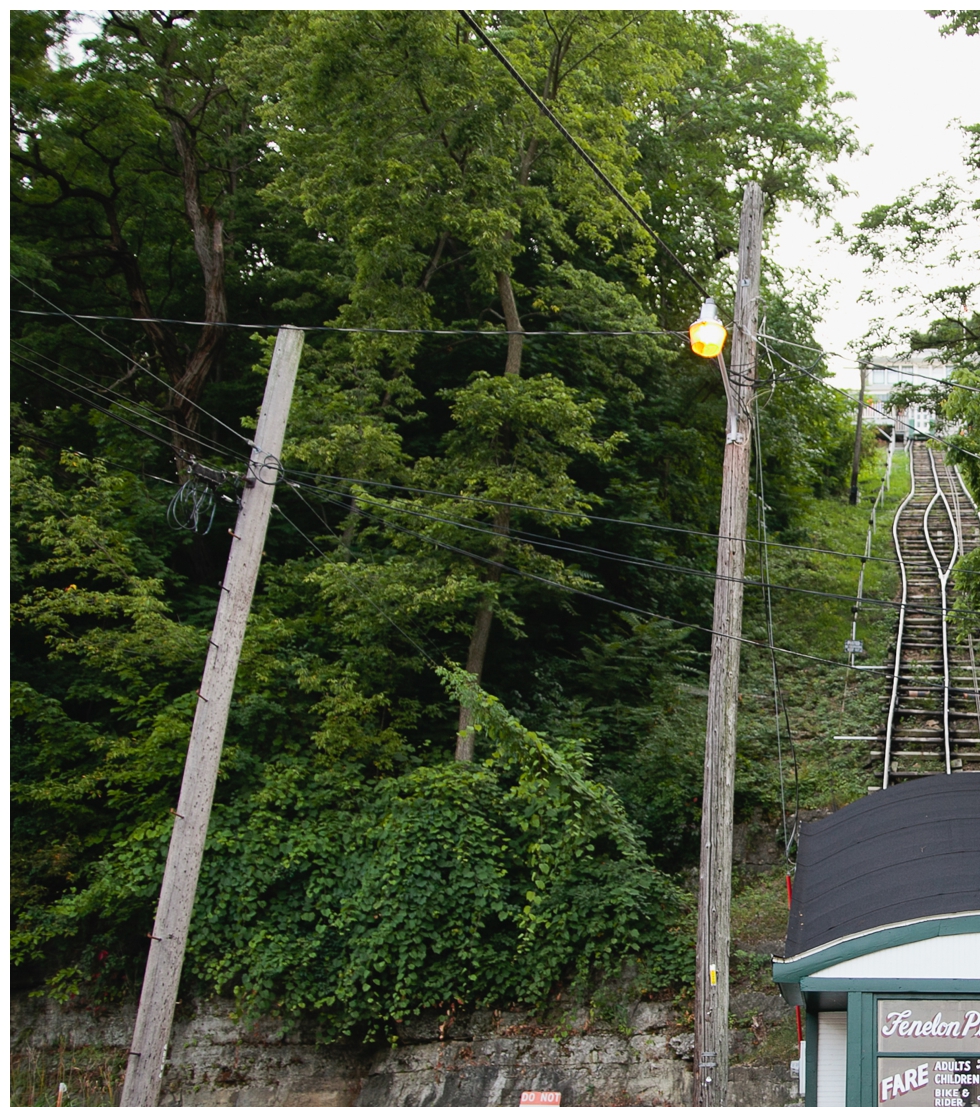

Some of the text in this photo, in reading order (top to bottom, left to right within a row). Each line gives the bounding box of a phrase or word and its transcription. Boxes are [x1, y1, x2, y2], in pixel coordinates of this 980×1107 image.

[882, 1009, 960, 1037] Fenelon
[934, 1061, 971, 1071] ADULTS
[881, 1063, 929, 1101] FARE
[934, 1074, 980, 1084] CHILDREN
[521, 1092, 560, 1102] DO NOT
[935, 1089, 970, 1097] BIKE &
[935, 1098, 963, 1107] RIDER
